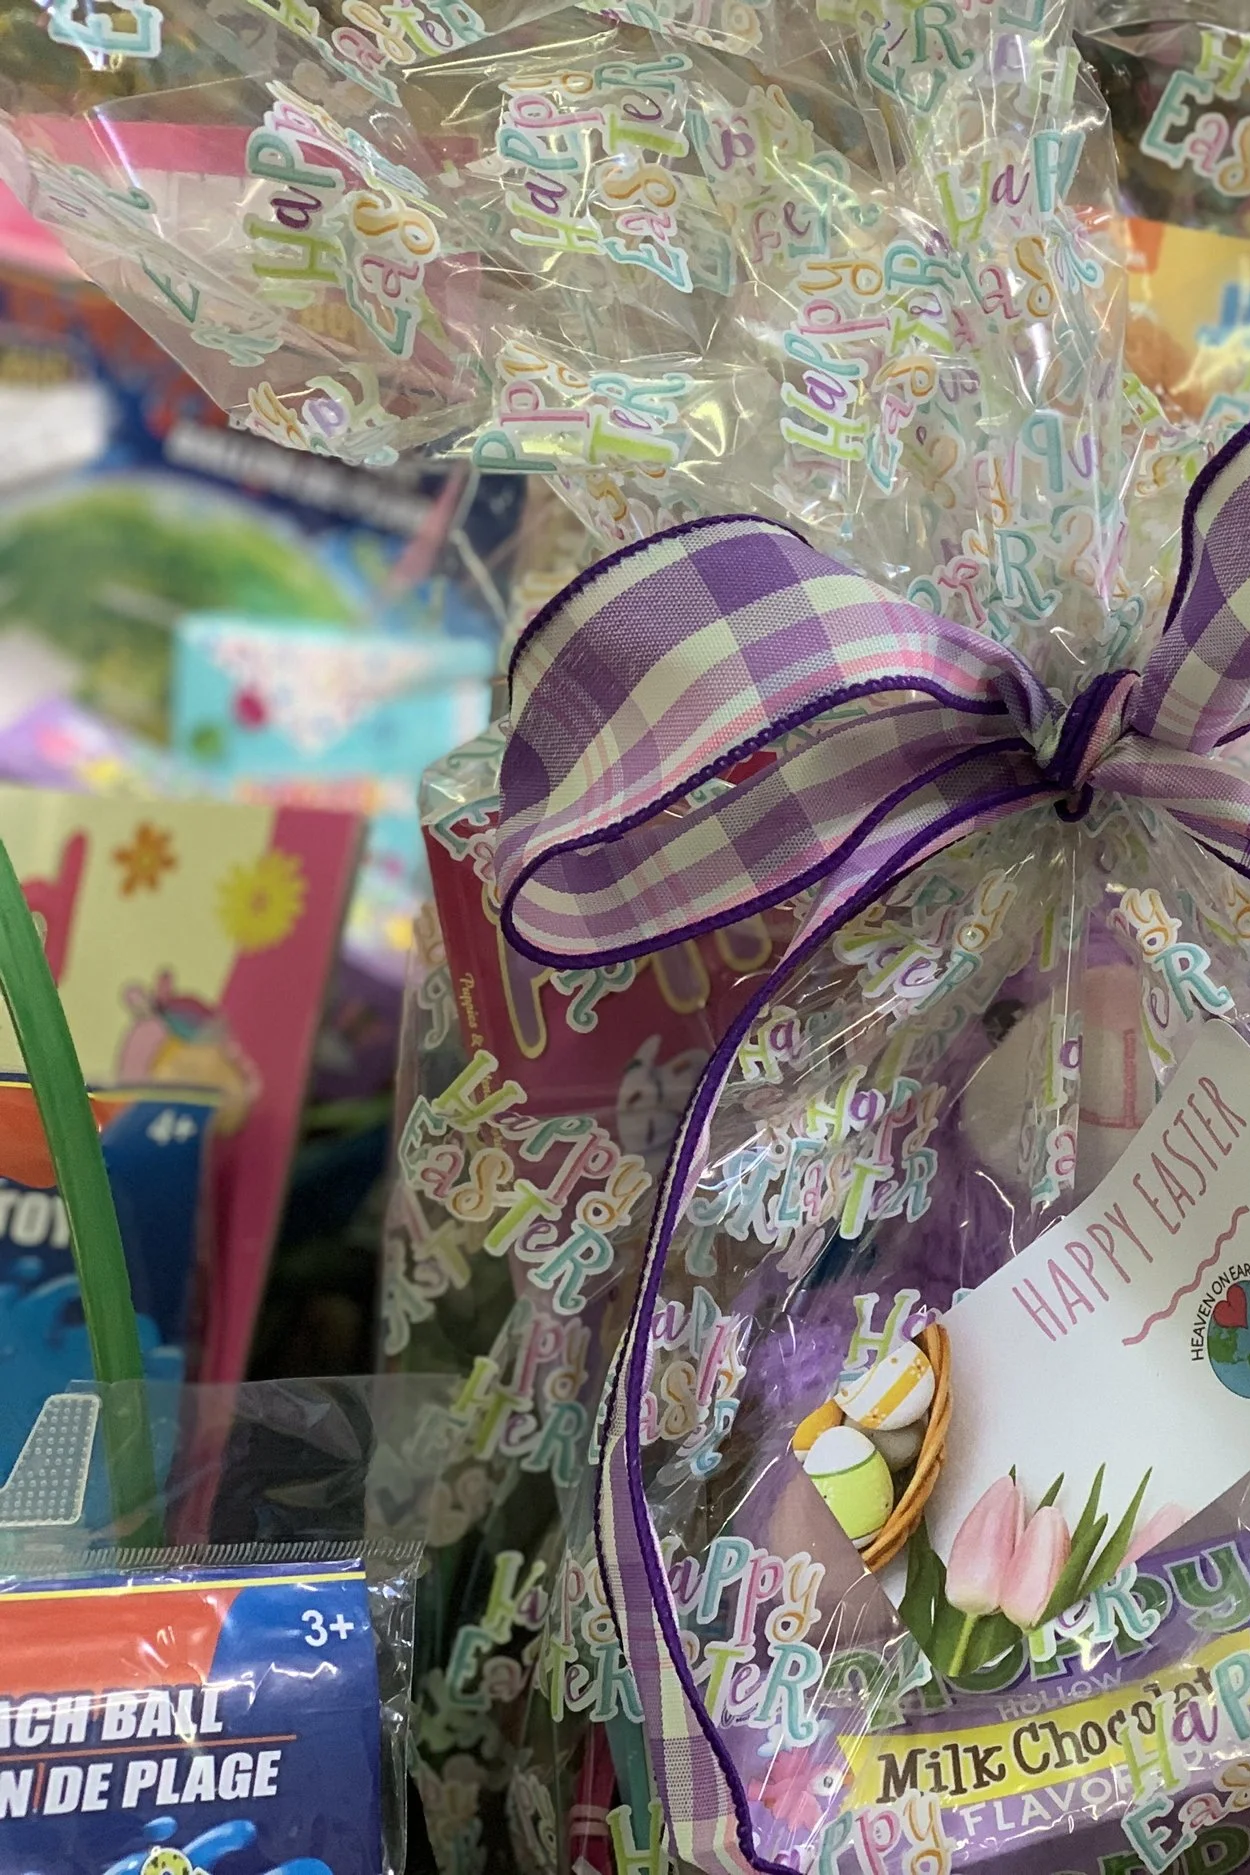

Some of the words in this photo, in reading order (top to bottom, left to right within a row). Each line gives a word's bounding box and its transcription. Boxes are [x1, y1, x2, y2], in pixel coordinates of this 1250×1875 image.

[145, 1107, 198, 1147] 4+
[1011, 1202, 1154, 1342] HAPPY
[1132, 1076, 1247, 1234] EASTER
[1191, 1292, 1216, 1361] HEAVEN
[1211, 1271, 1231, 1295] ON
[669, 1542, 820, 1646] aPpy
[301, 1609, 355, 1648] 3+
[101, 1688, 225, 1742] BALL
[704, 1645, 824, 1741] TeR
[996, 1667, 1124, 1722] HOLLOW
[43, 1763, 113, 1816] DE
[122, 1750, 282, 1809] PLAGE
[876, 1741, 1006, 1804] Milk
